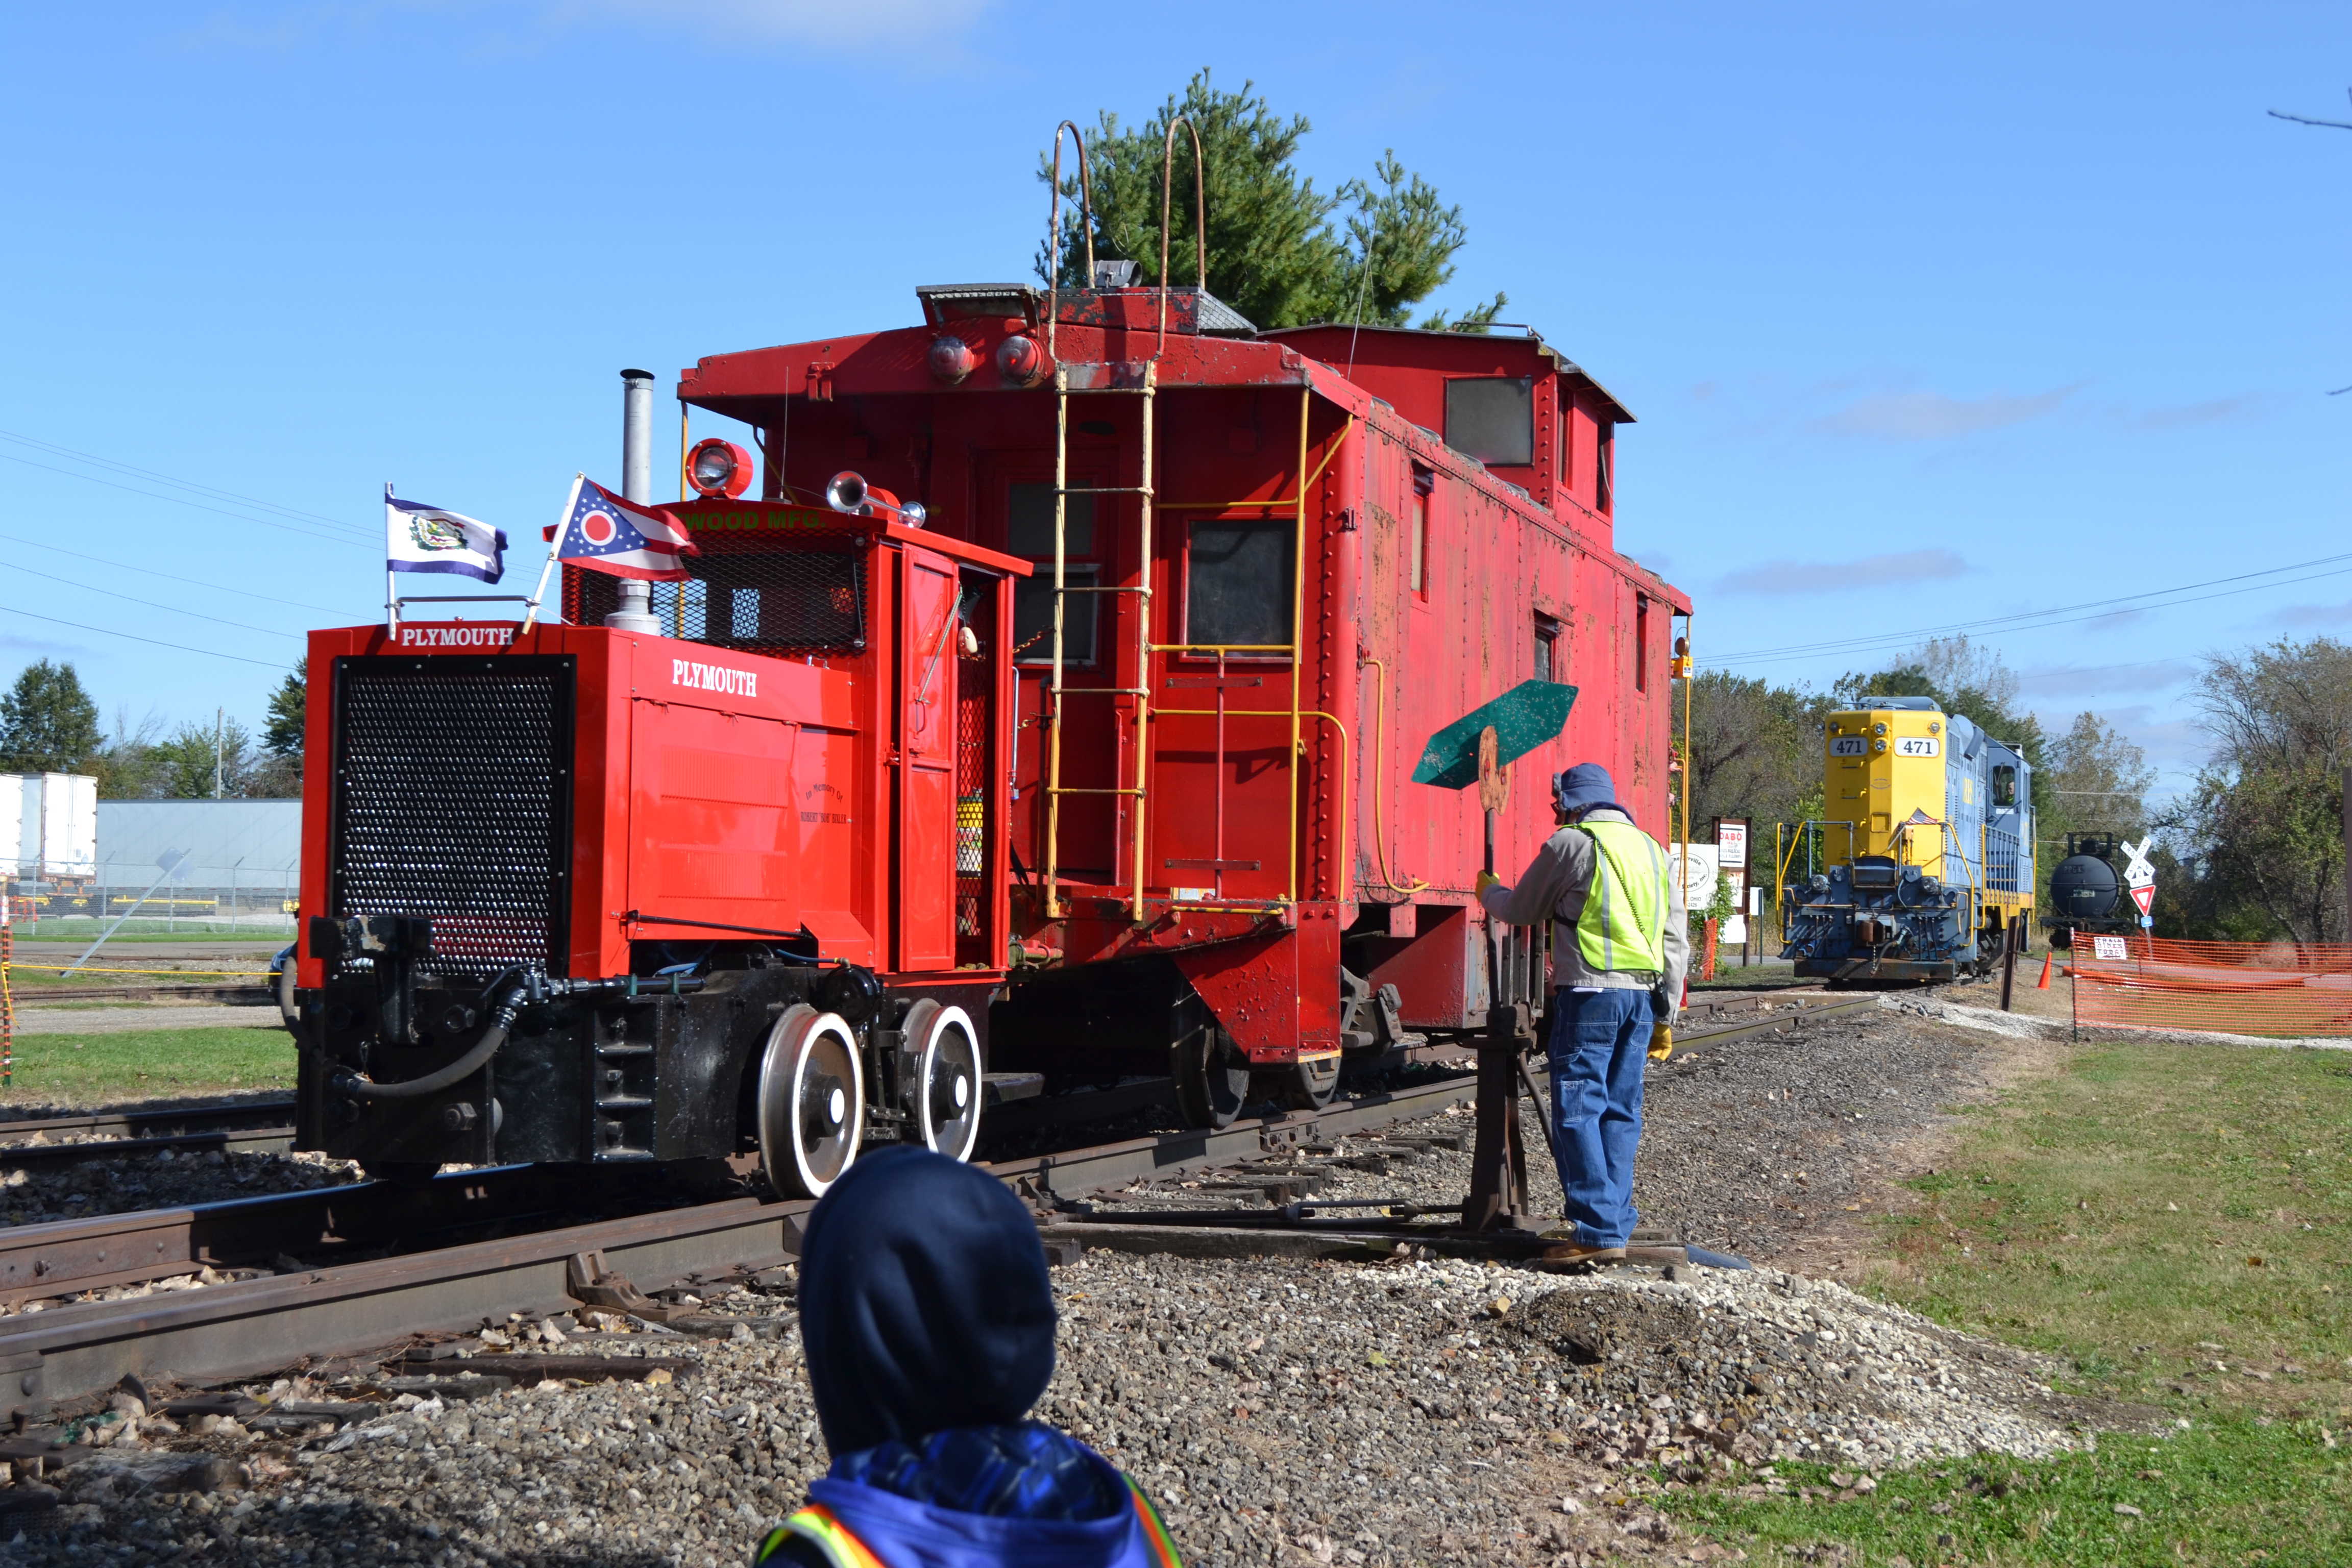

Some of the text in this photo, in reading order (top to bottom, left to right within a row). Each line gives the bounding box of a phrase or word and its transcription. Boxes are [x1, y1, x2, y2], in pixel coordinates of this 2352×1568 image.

[676, 510, 826, 530] WOOD MFG.
[402, 628, 514, 646] PLYMOUTH
[672, 658, 757, 697] PLYMOUTH
[1836, 740, 1863, 753] 471
[1903, 740, 1932, 754] 471
[813, 783, 835, 797] Memory
[1699, 874, 1707, 883] Inc.
